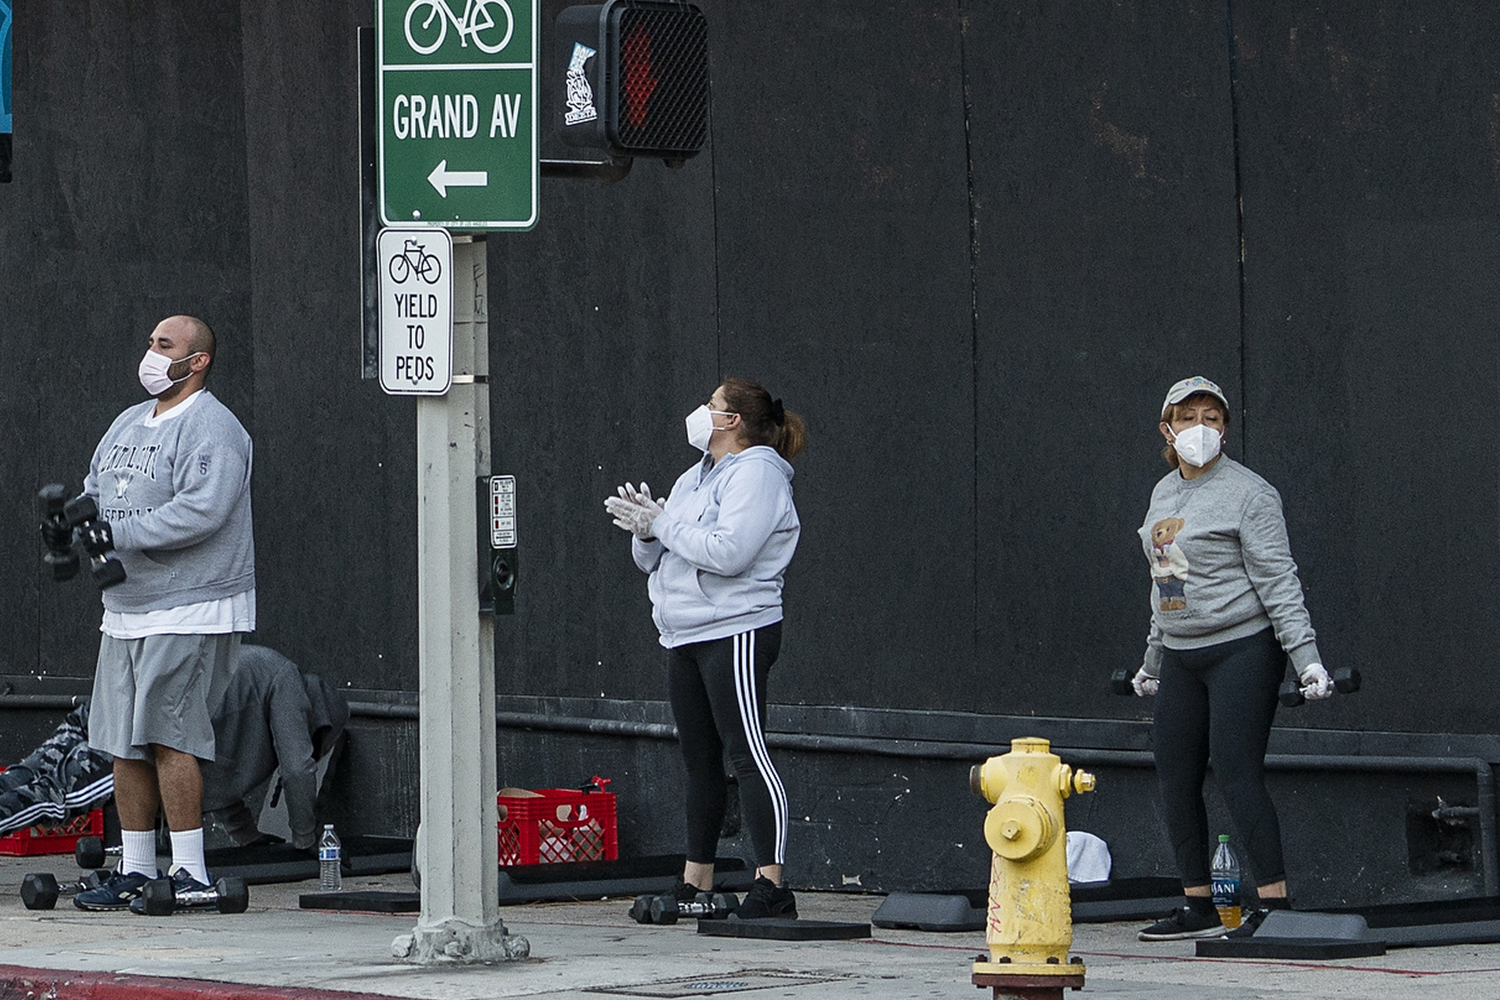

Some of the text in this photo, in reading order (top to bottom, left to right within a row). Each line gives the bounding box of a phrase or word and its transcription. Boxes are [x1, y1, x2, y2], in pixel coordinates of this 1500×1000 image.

[393, 93, 521, 140] GRAND AV
[394, 293, 438, 318] YIELD
[406, 325, 425, 349] TO
[396, 356, 434, 380] PEDS
